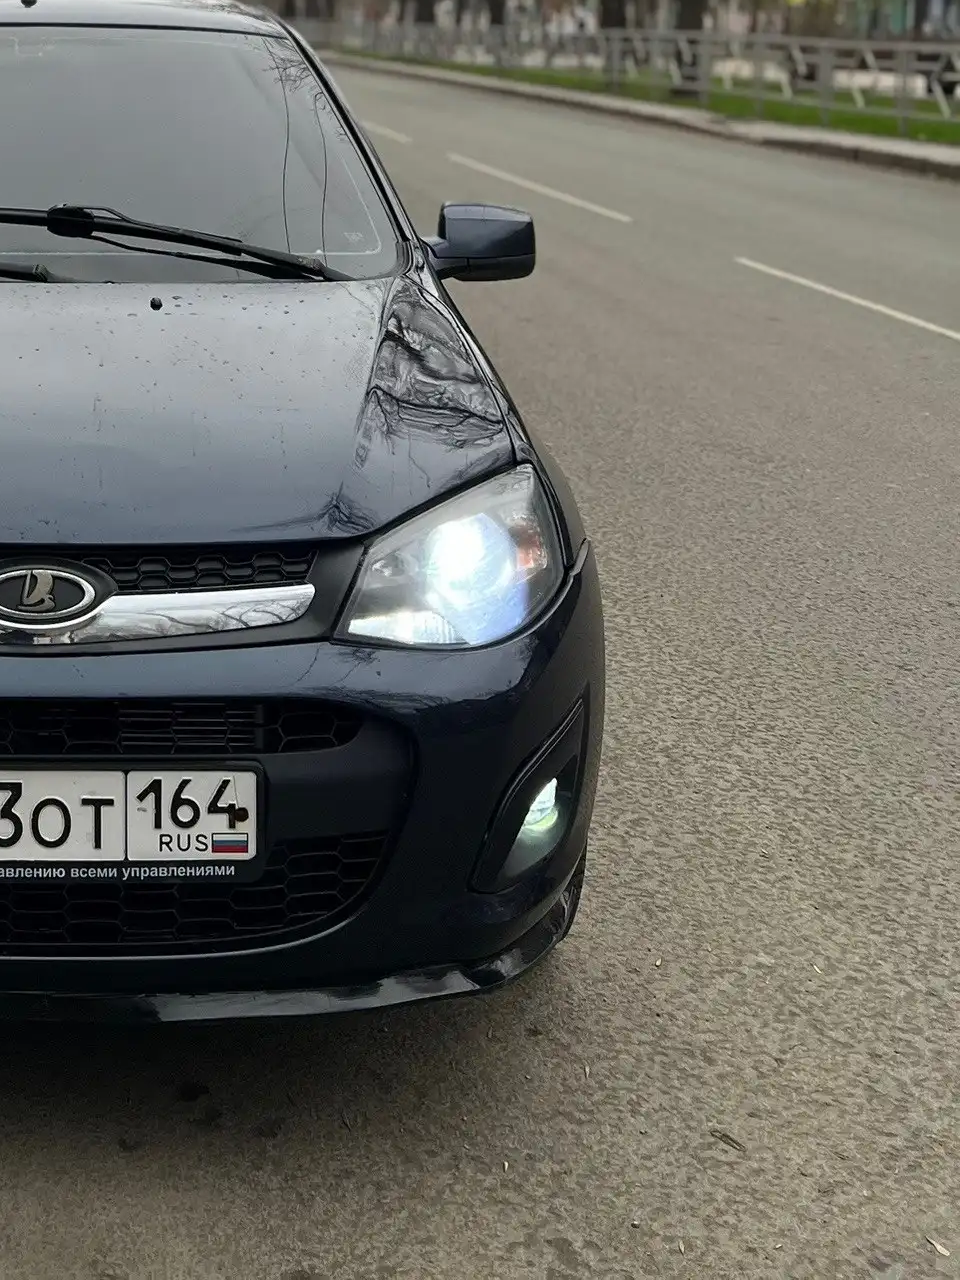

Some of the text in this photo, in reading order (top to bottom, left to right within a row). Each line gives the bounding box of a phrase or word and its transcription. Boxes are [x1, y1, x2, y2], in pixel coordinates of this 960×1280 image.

[136, 777, 238, 830] 164
[158, 833, 209, 853] RUS
[70, 867, 118, 878] всеми
[122, 865, 236, 880] управлениями
